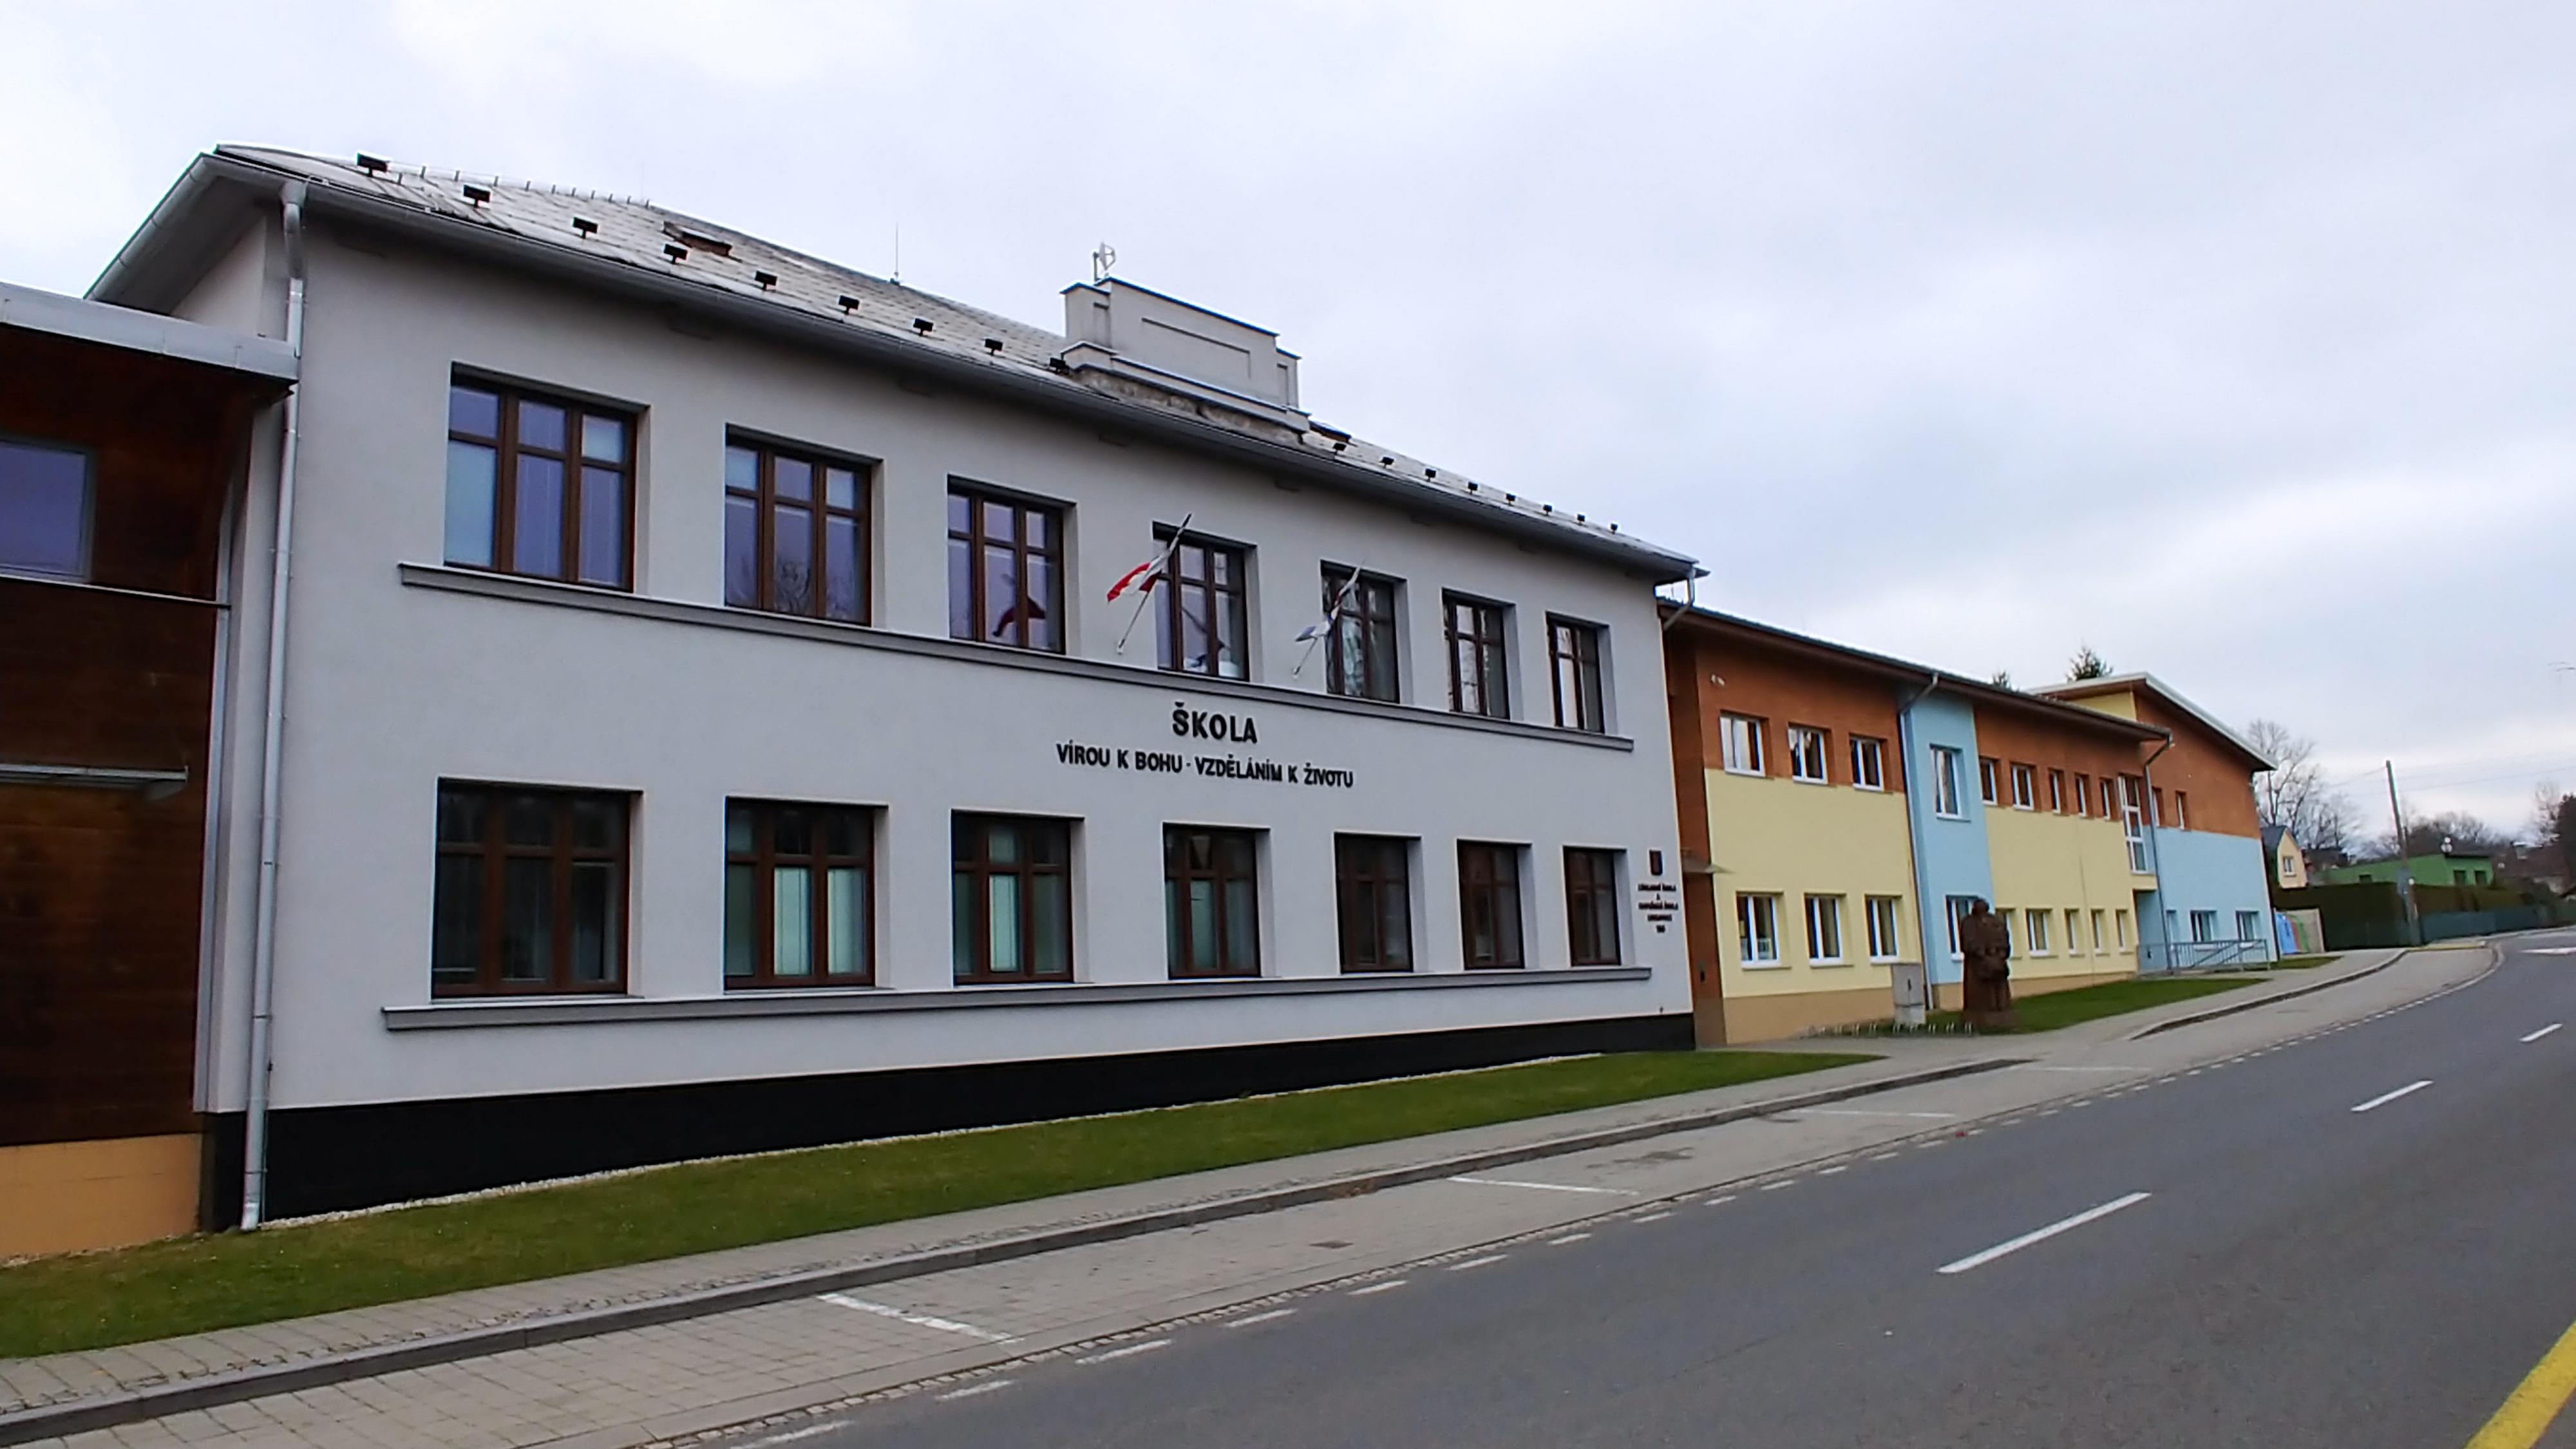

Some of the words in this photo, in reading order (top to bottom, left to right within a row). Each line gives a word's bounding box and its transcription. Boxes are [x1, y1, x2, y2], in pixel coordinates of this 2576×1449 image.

[1172, 701, 1258, 744] ŠKOLA
[1056, 739, 1110, 768] VÍROU
[1117, 749, 1130, 770] K
[1135, 751, 1183, 773] BOHU
[1194, 753, 1283, 782] VZDĚLÁNÍM
[1287, 765, 1298, 784] K
[1303, 762, 1354, 788] ŽIVOTU
